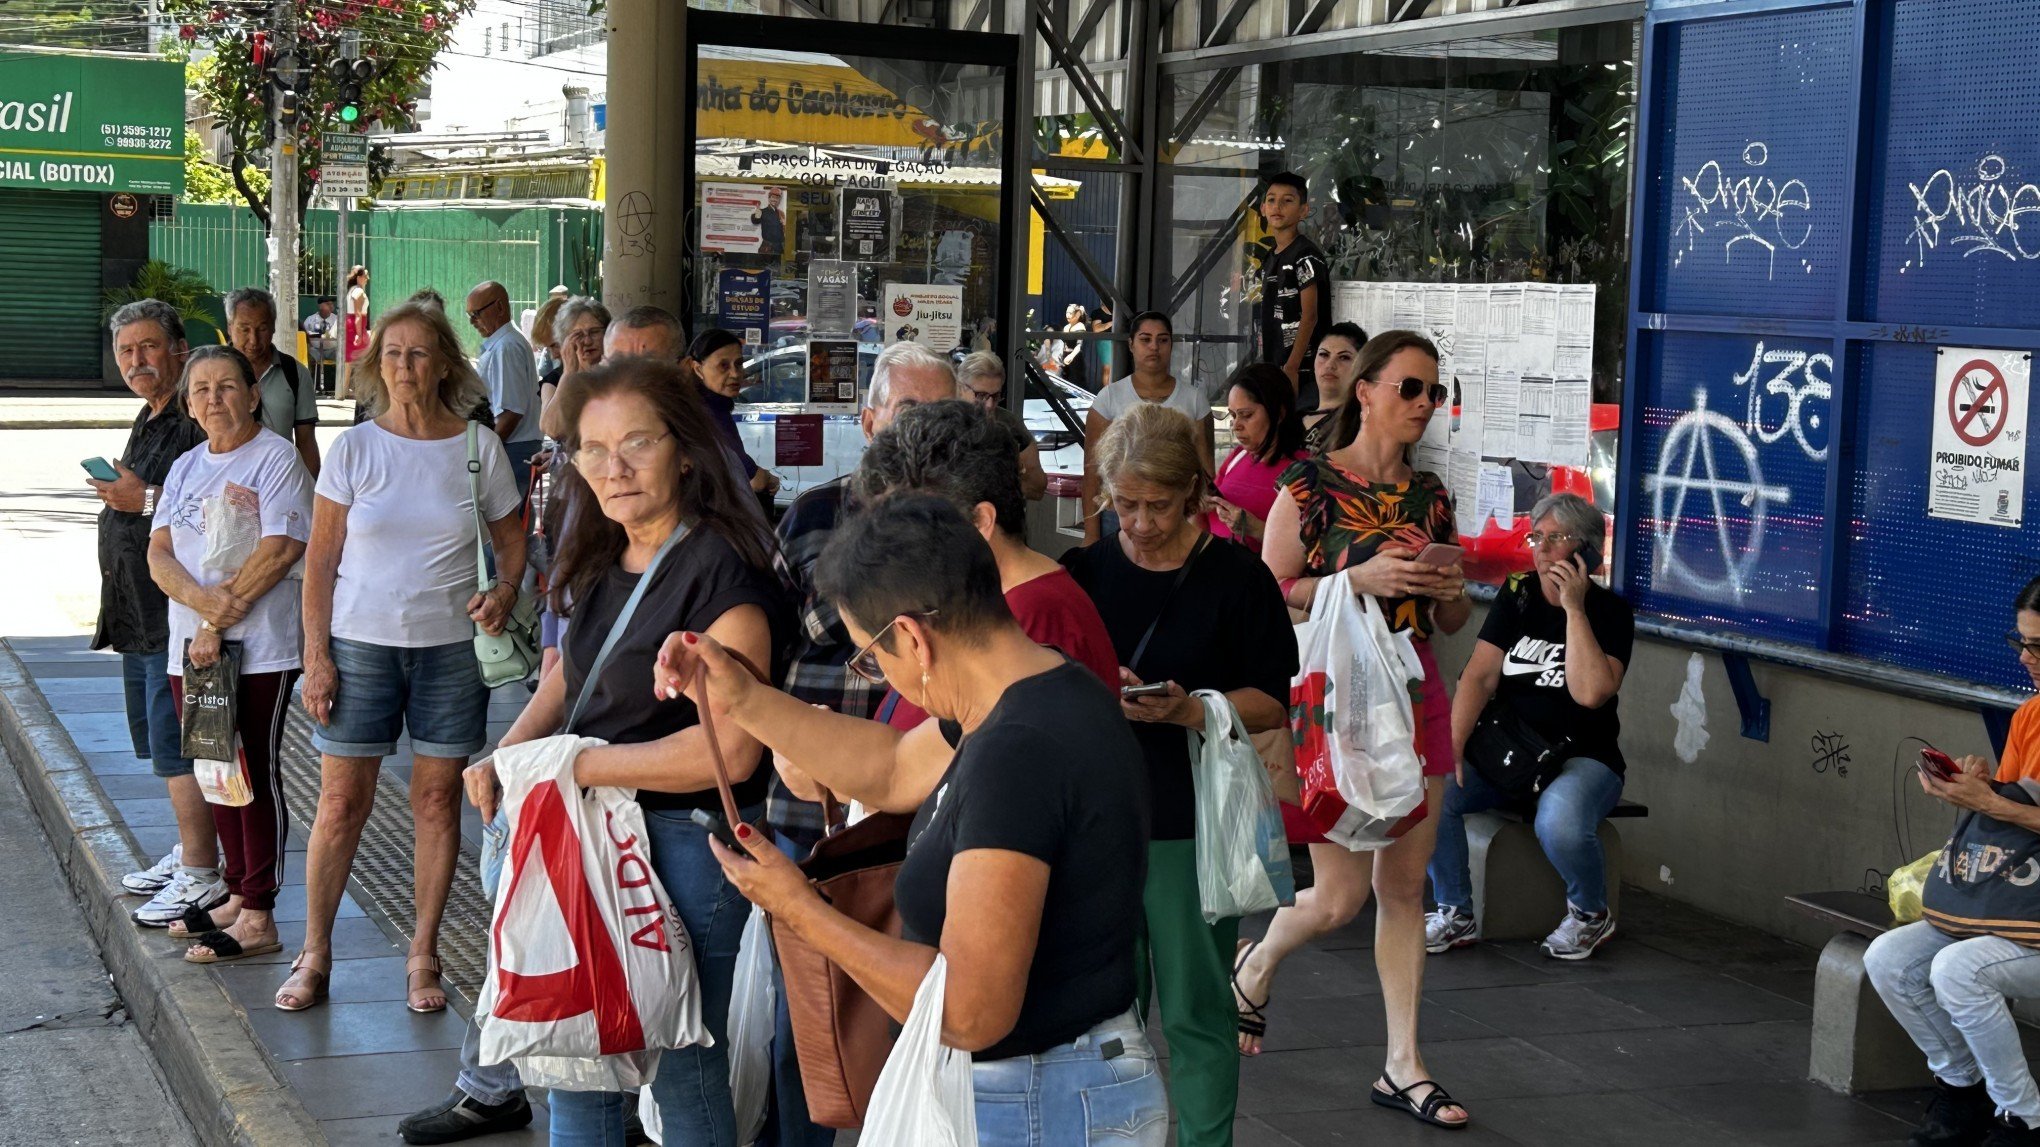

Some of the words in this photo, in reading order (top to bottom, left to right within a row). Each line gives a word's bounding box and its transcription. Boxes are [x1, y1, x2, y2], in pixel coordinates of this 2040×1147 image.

[750, 77, 780, 114] do
[0, 91, 73, 133] asil
[101, 124, 120, 135] (51)
[40, 161, 115, 186] (BOTOX)
[752, 152, 810, 168] ESPAÇO
[814, 156, 851, 170] PARA
[855, 159, 945, 176] DIVLGAÇÃO
[801, 172, 843, 187] COLE
[850, 175, 885, 189] AQUI
[801, 191, 831, 205] SEU
[916, 310, 953, 321] Jiu-Jitsu
[1936, 451, 1982, 468] PROIBIDO
[1984, 456, 2020, 471] FUMAR
[1511, 636, 1565, 666] NIKE
[1535, 670, 1565, 688] SB
